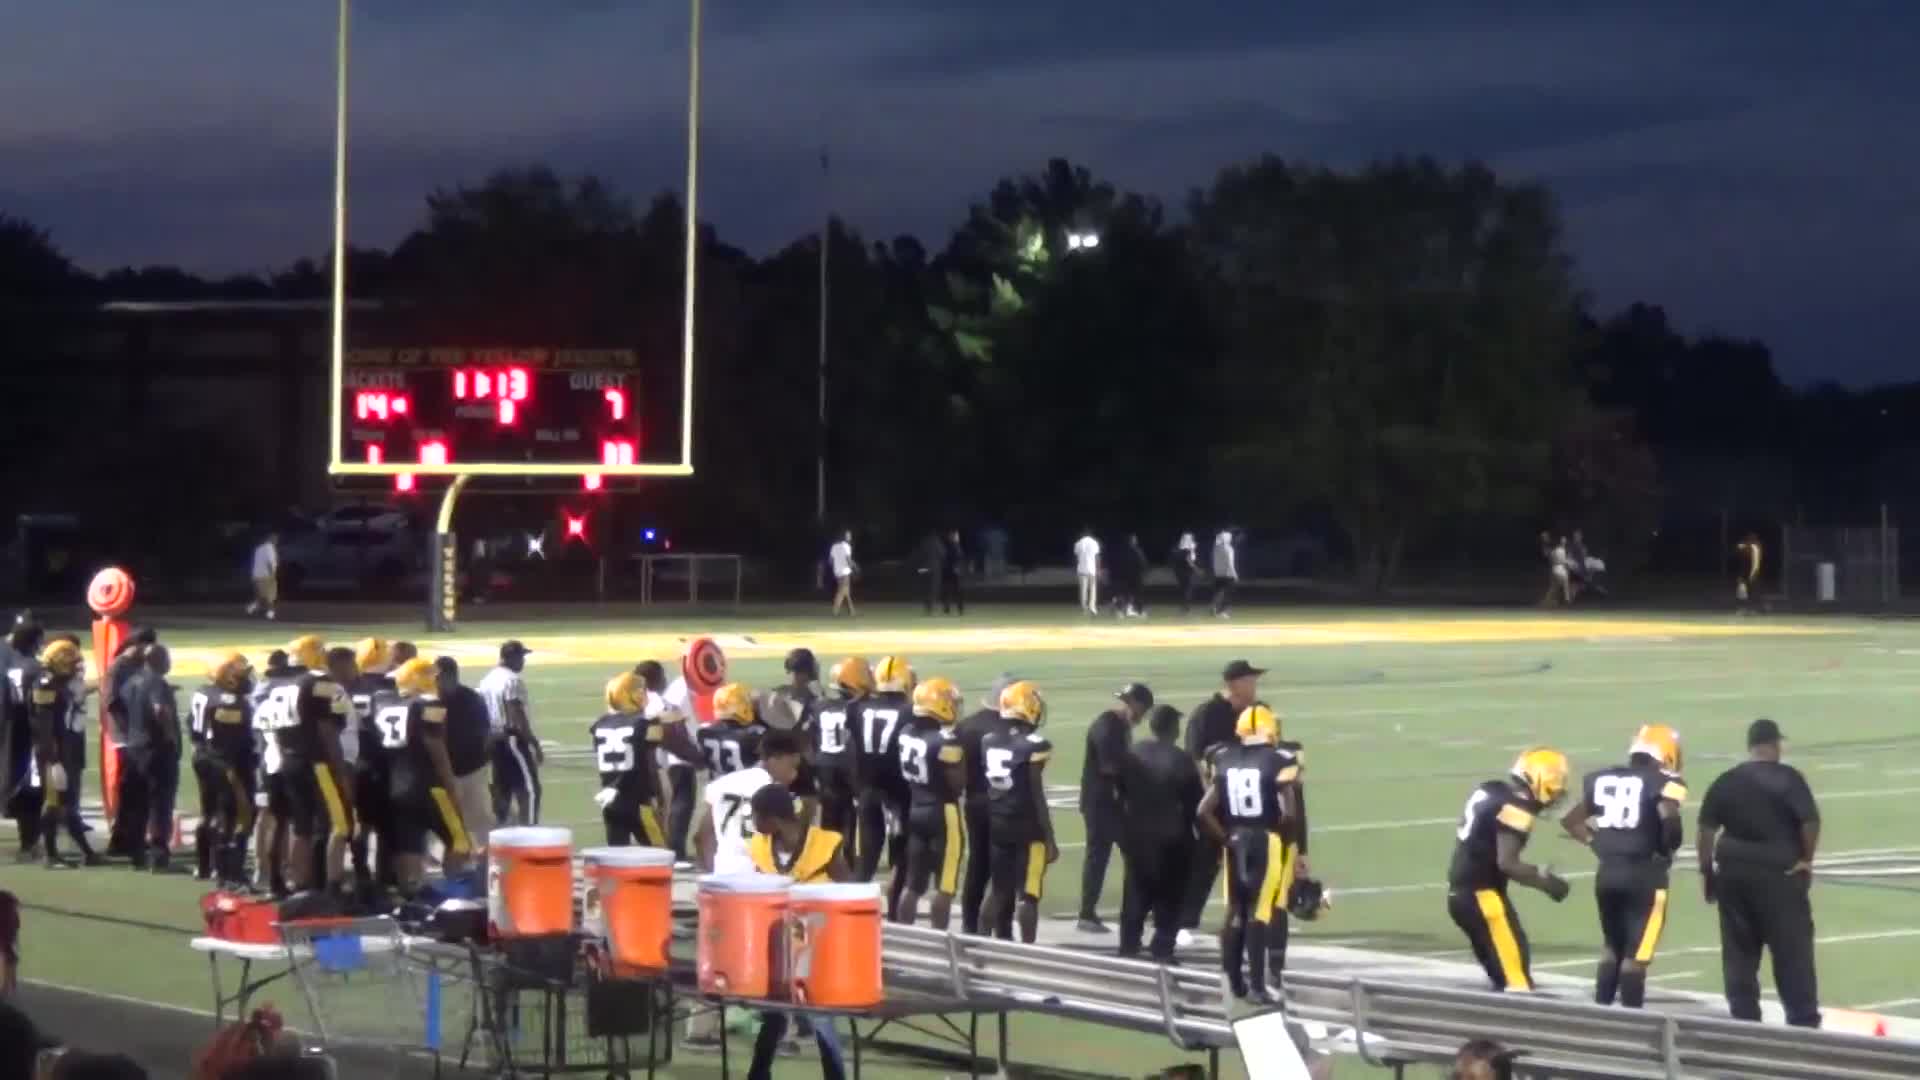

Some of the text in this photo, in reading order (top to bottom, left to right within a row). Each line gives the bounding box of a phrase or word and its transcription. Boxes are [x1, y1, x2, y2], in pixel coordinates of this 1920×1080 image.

[357, 393, 388, 420] 14
[606, 391, 623, 420] 7
[597, 727, 635, 772] 25
[862, 708, 900, 754] 17
[1227, 767, 1263, 817] 18
[1594, 775, 1644, 829] 58
